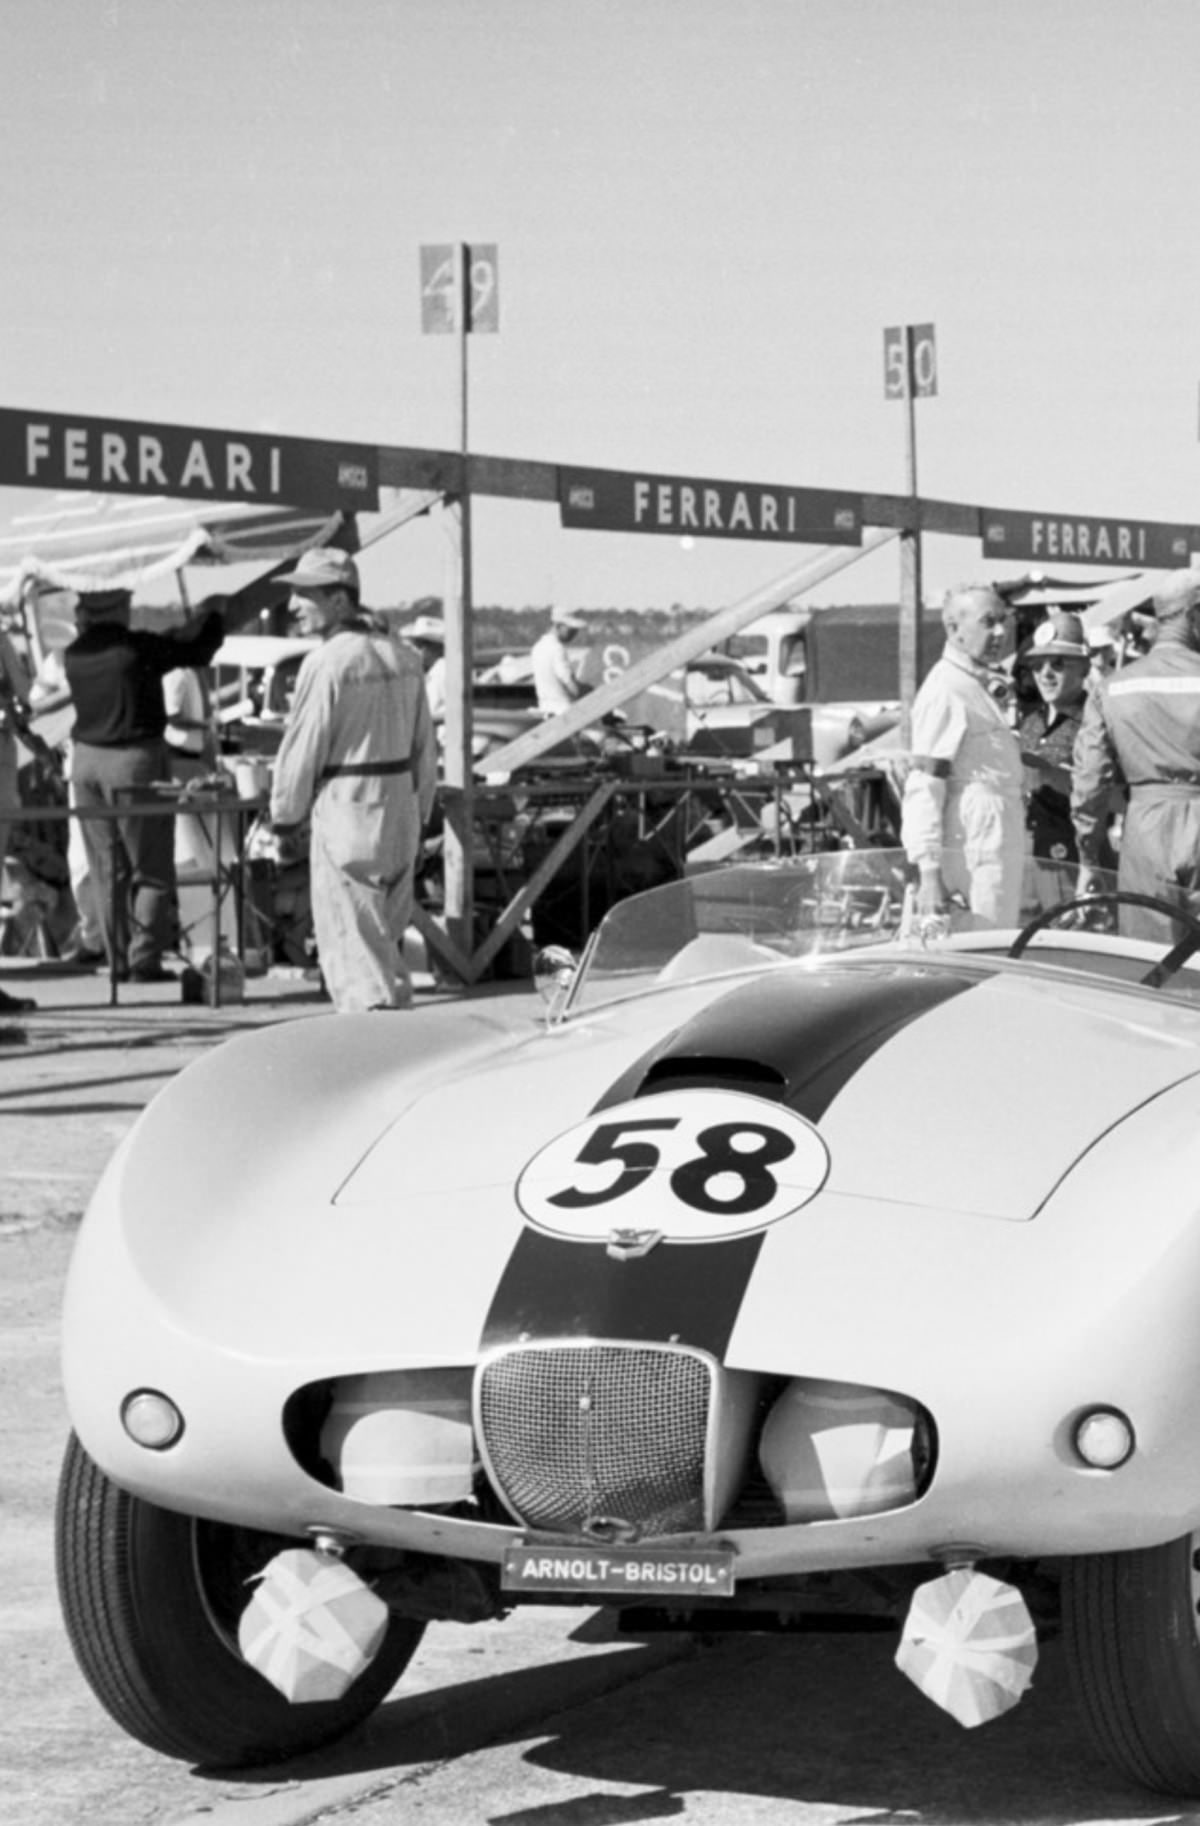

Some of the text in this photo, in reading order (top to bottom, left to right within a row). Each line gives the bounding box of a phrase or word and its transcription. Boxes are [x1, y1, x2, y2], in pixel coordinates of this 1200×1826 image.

[423, 259, 494, 322] 49
[885, 338, 936, 391] 50
[26, 422, 281, 494] FERRARI
[633, 480, 796, 533] FERRARI
[1031, 520, 1146, 562] FERRARI
[545, 1117, 796, 1215] 58
[521, 1557, 718, 1585] ARNOLT-BRISTOL
